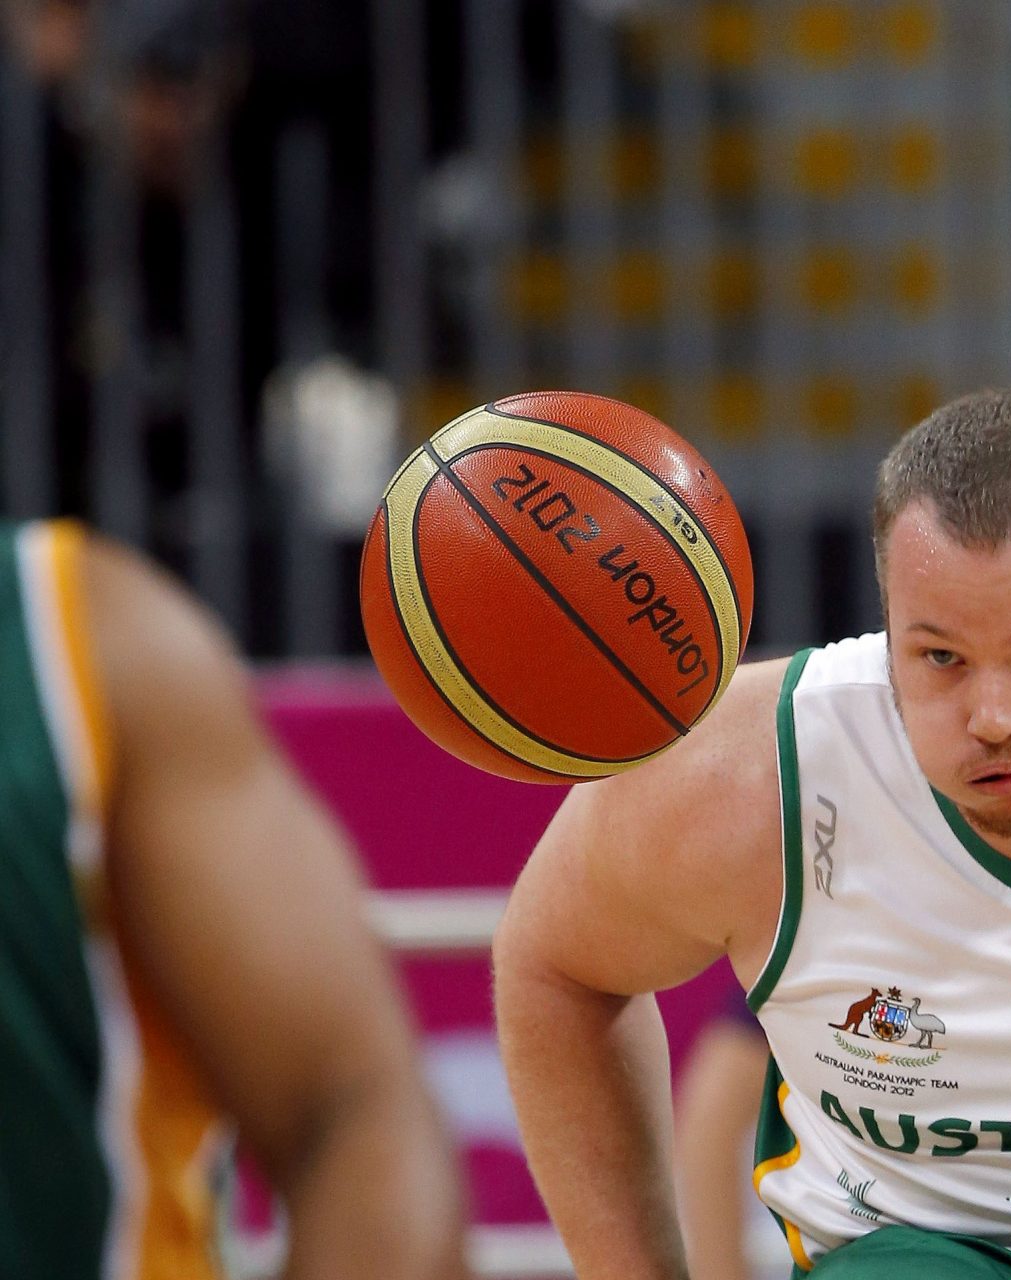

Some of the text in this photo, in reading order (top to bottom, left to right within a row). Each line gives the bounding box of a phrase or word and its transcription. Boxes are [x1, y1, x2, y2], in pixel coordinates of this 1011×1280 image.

[491, 464, 710, 698] London 2012
[814, 1051, 959, 1090] AUSTRALIAN PARALYMPIC TEAM
[843, 1073, 915, 1097] LONDON 2012
